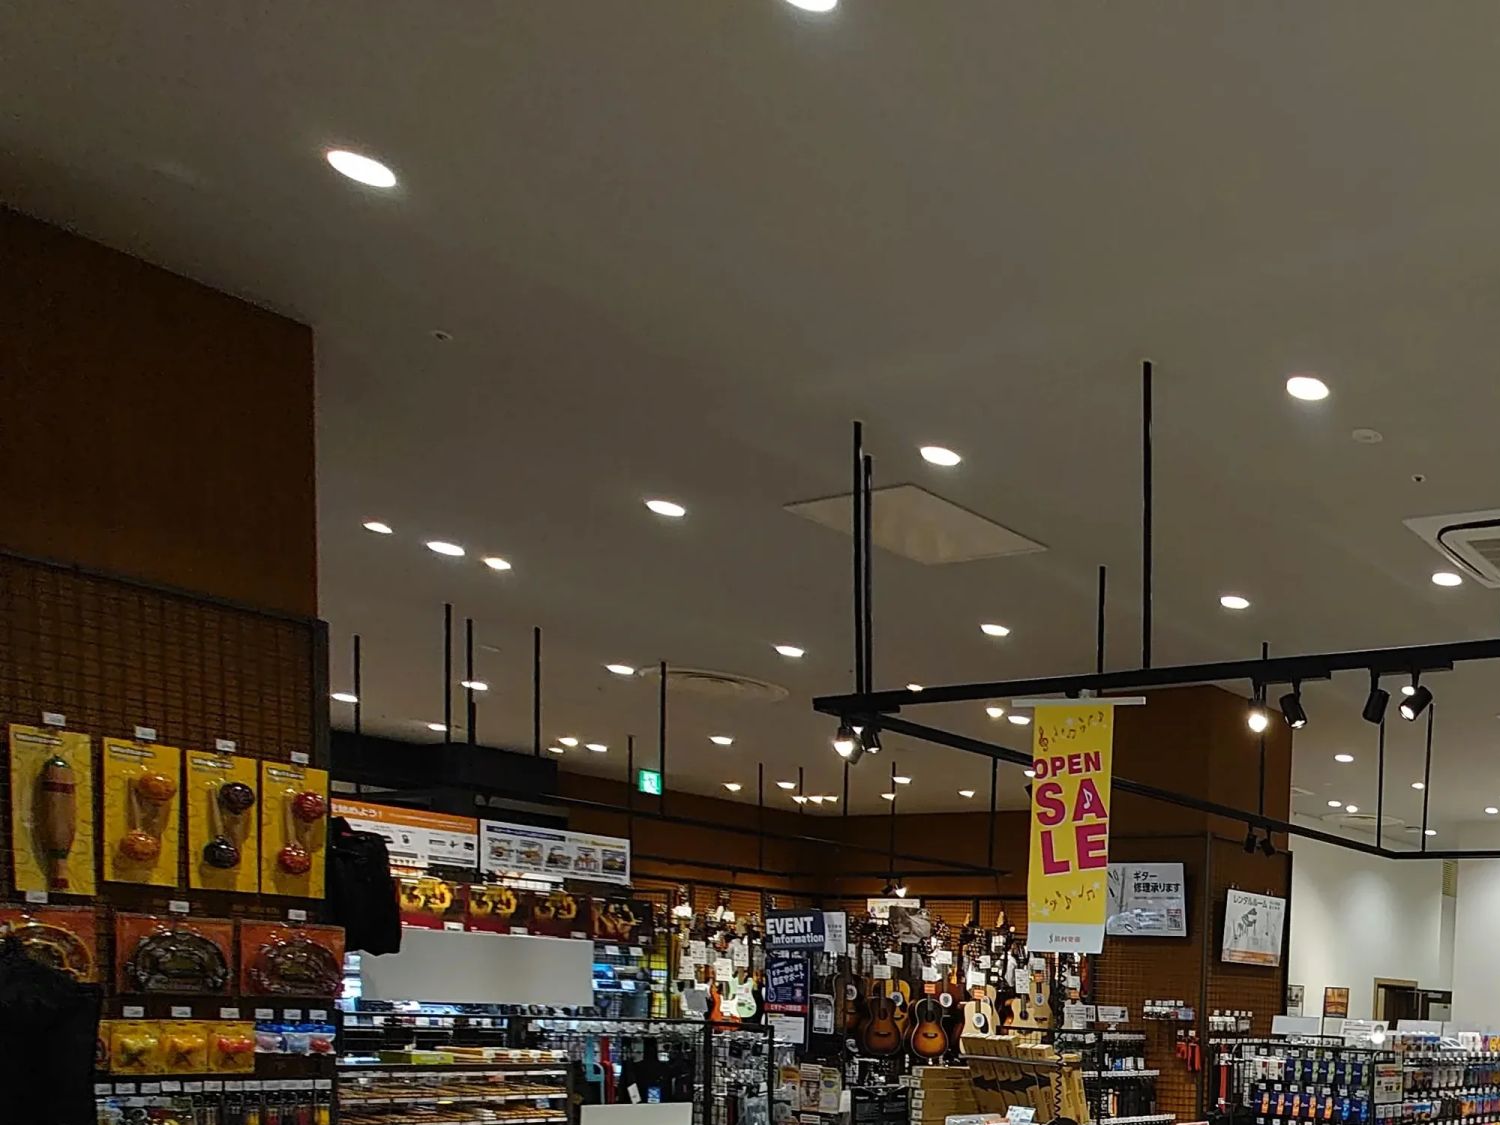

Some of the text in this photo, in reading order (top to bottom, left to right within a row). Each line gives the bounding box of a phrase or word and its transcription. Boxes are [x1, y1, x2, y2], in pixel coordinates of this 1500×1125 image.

[1032, 751, 1101, 779] OPEN
[1133, 871, 1157, 881] ギター
[1134, 882, 1181, 893] 修理承ります
[766, 917, 813, 935] EVENT
[772, 933, 824, 944] Information
